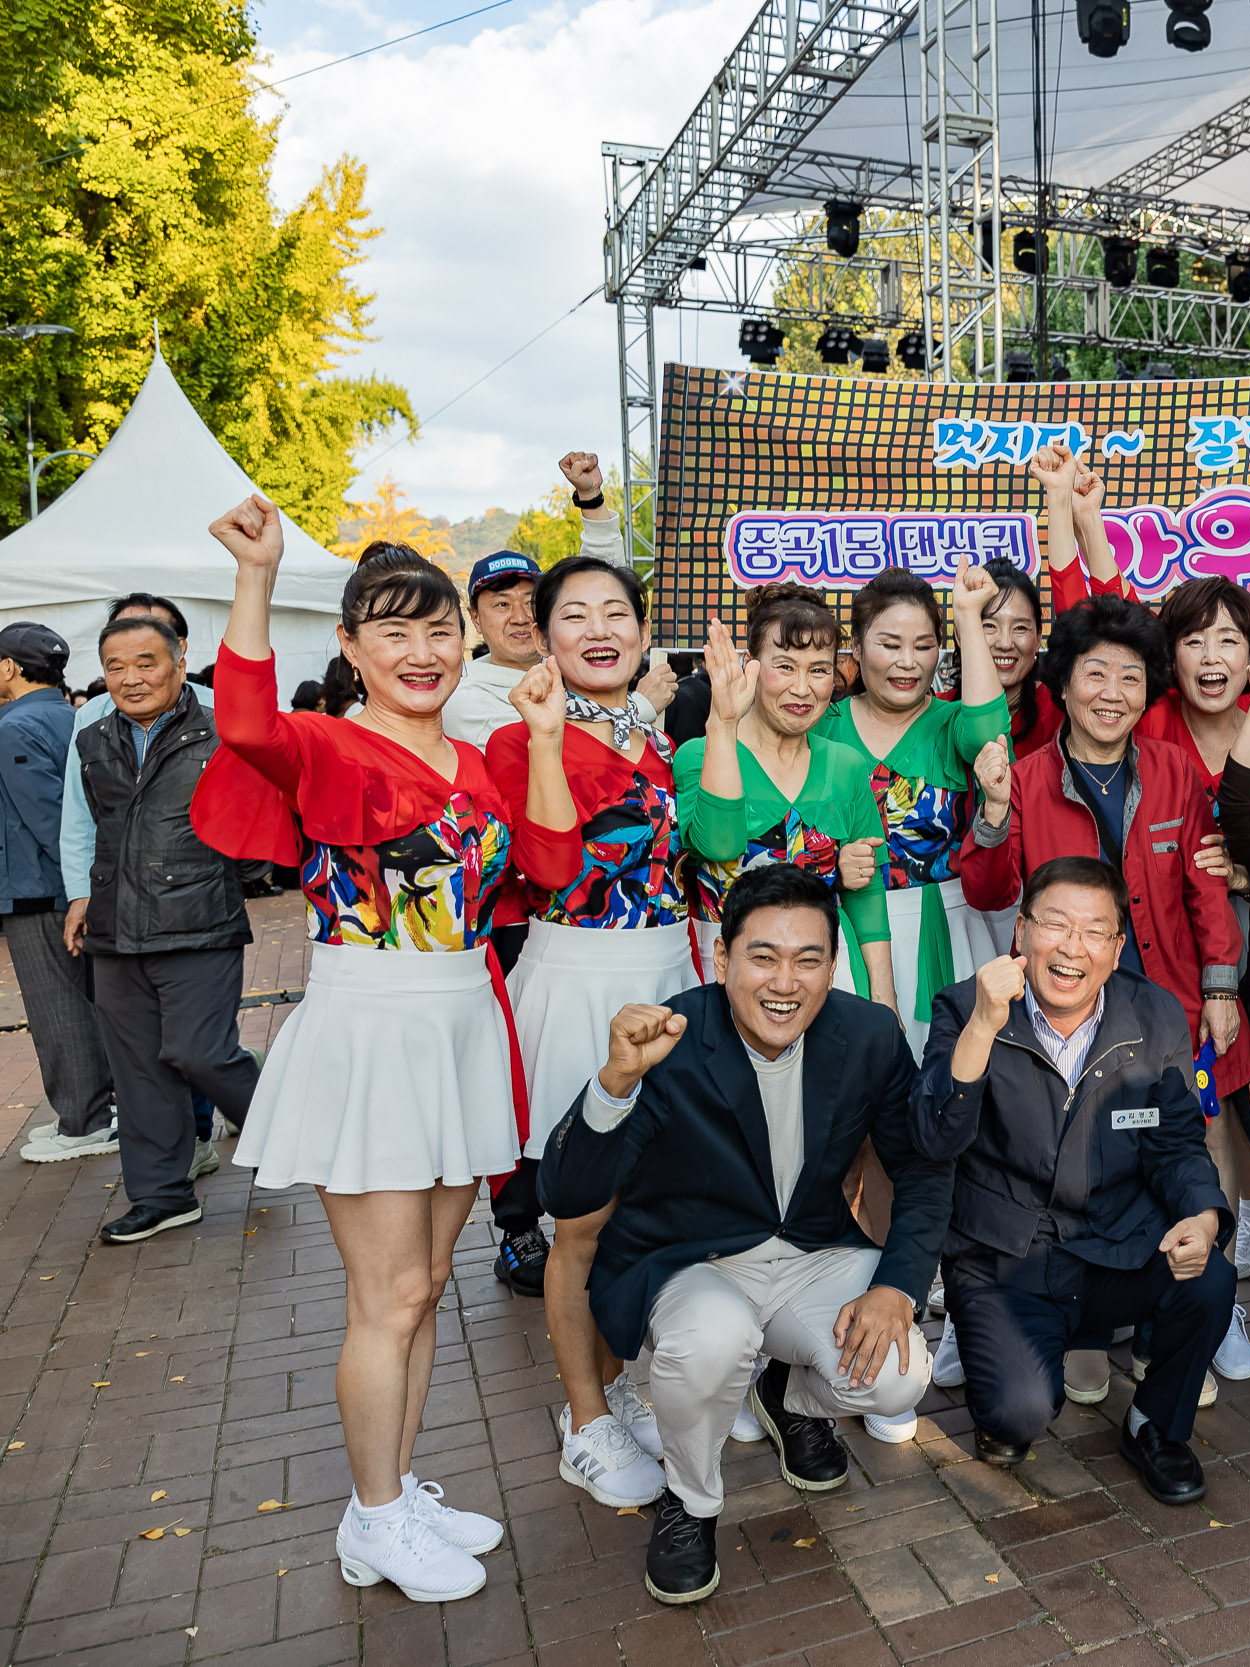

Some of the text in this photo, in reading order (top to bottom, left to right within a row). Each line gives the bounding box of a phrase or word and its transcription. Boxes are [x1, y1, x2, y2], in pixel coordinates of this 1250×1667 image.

[936, 420, 1090, 468] 멋지다
[489, 557, 528, 571] DODGERS
[741, 524, 1022, 571] 중곡1동 댄싱퀸
